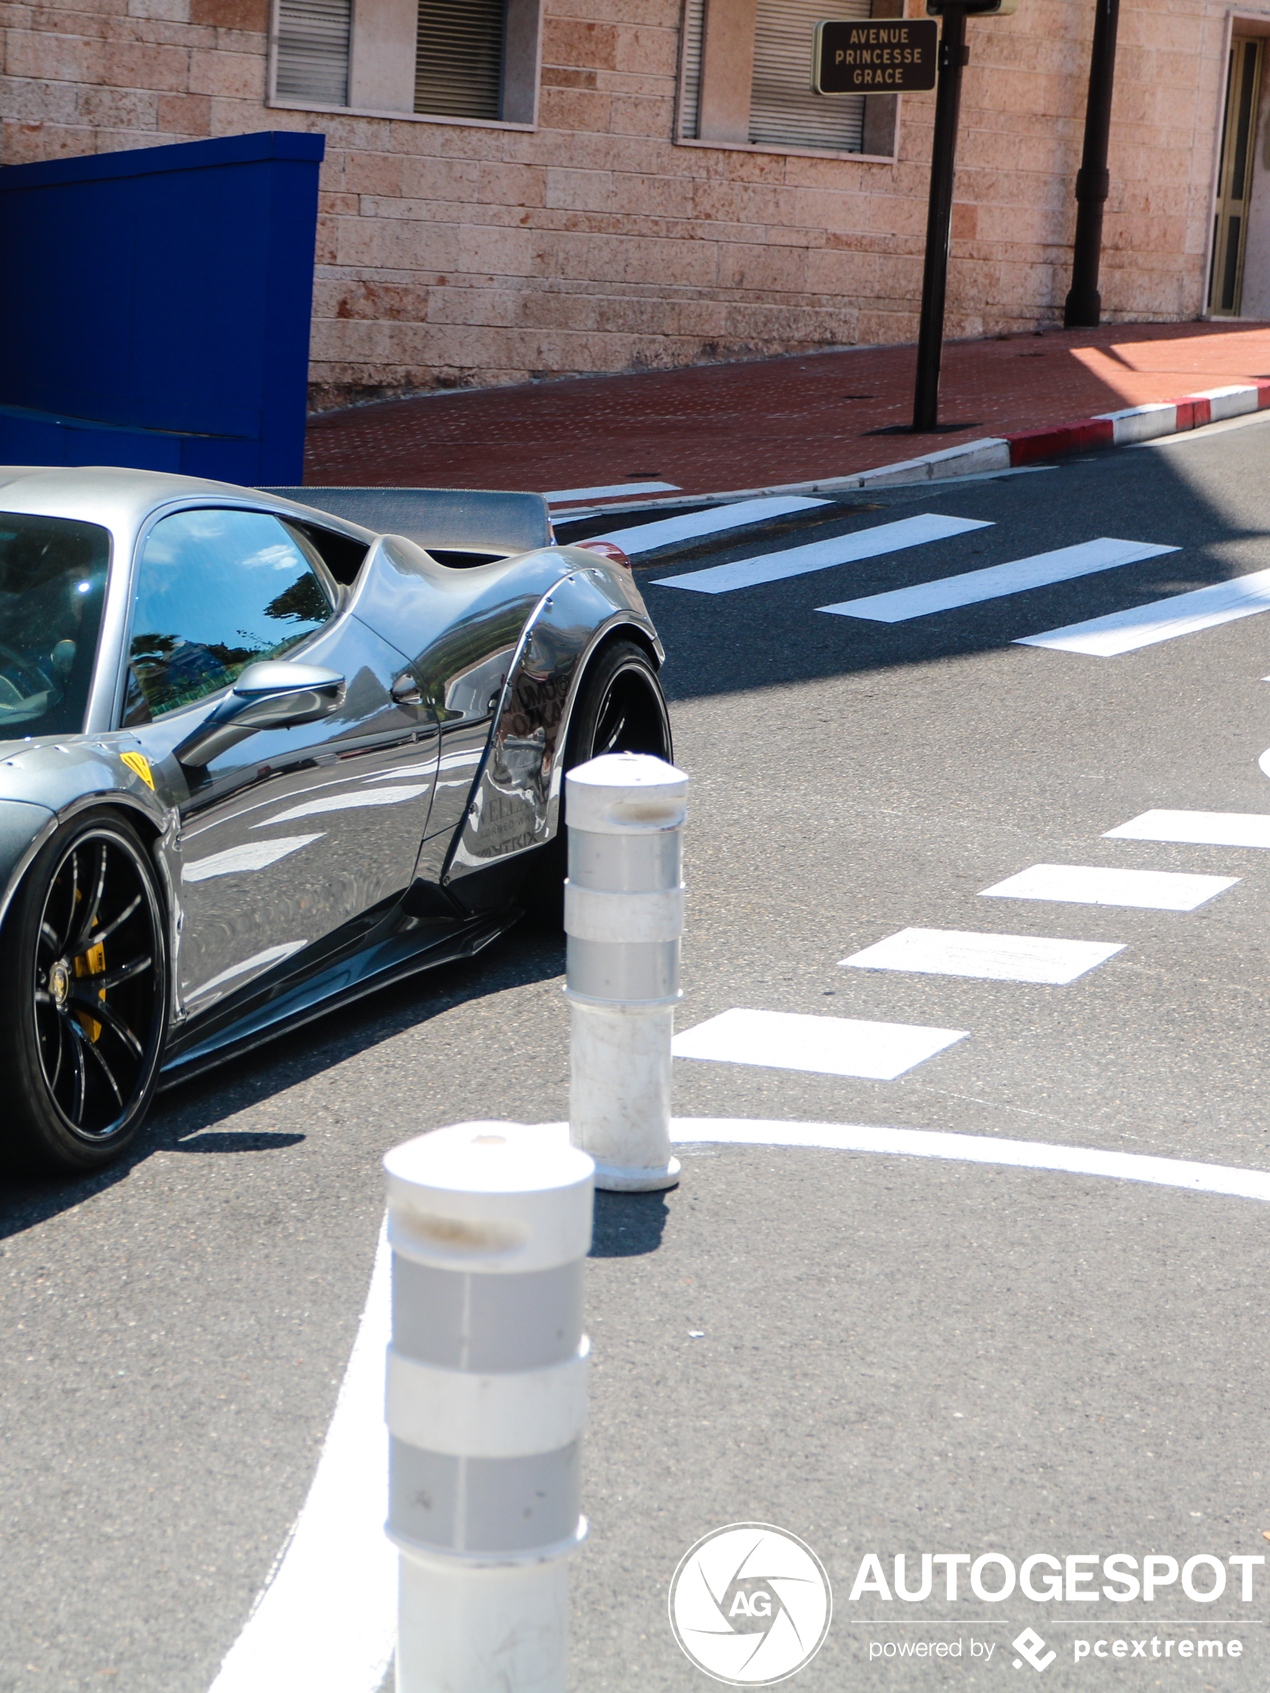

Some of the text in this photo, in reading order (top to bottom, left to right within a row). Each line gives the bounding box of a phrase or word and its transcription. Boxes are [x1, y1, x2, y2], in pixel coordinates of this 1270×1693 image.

[849, 28, 909, 44] AVENUE
[835, 48, 922, 65] PRINCESSE
[853, 69, 904, 84] GRACE
